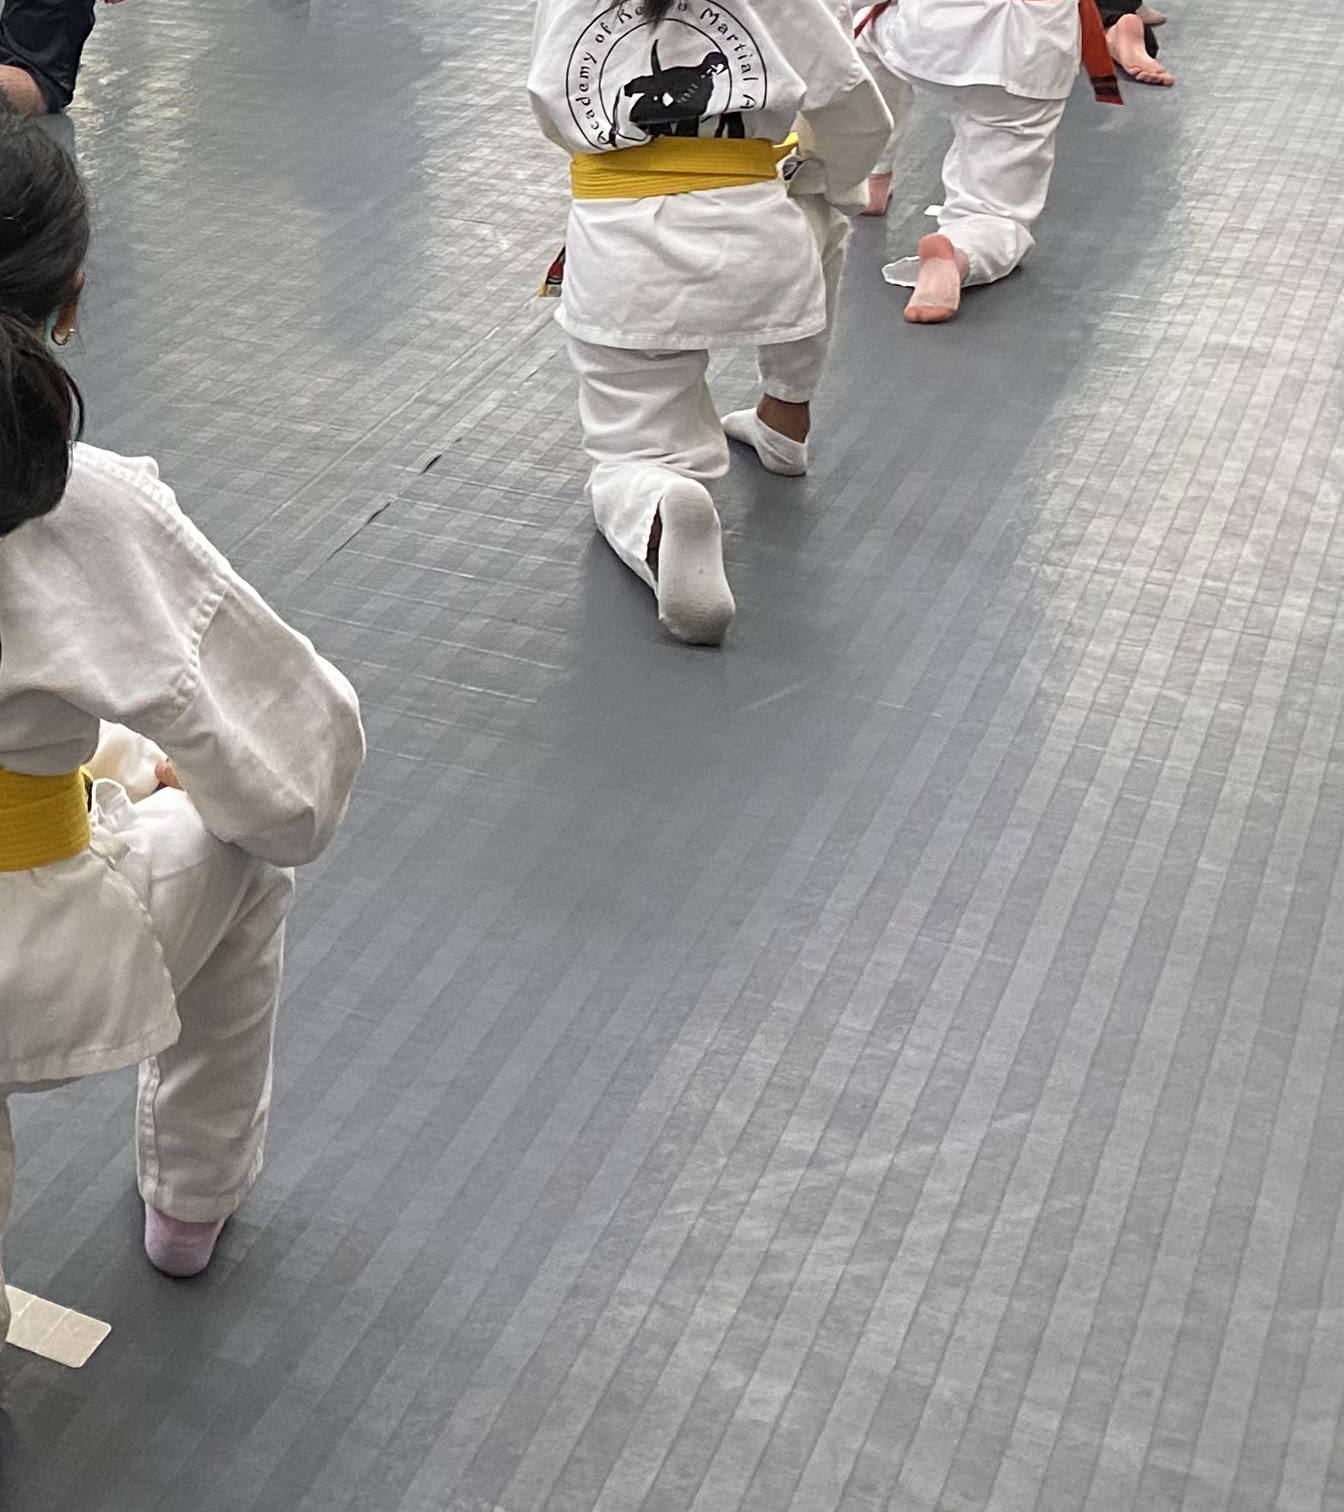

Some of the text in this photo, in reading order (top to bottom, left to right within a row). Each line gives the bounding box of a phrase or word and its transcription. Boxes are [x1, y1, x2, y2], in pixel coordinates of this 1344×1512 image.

[575, 51, 611, 146] Academy
[595, 21, 612, 44] of
[699, 7, 759, 82] Martial
